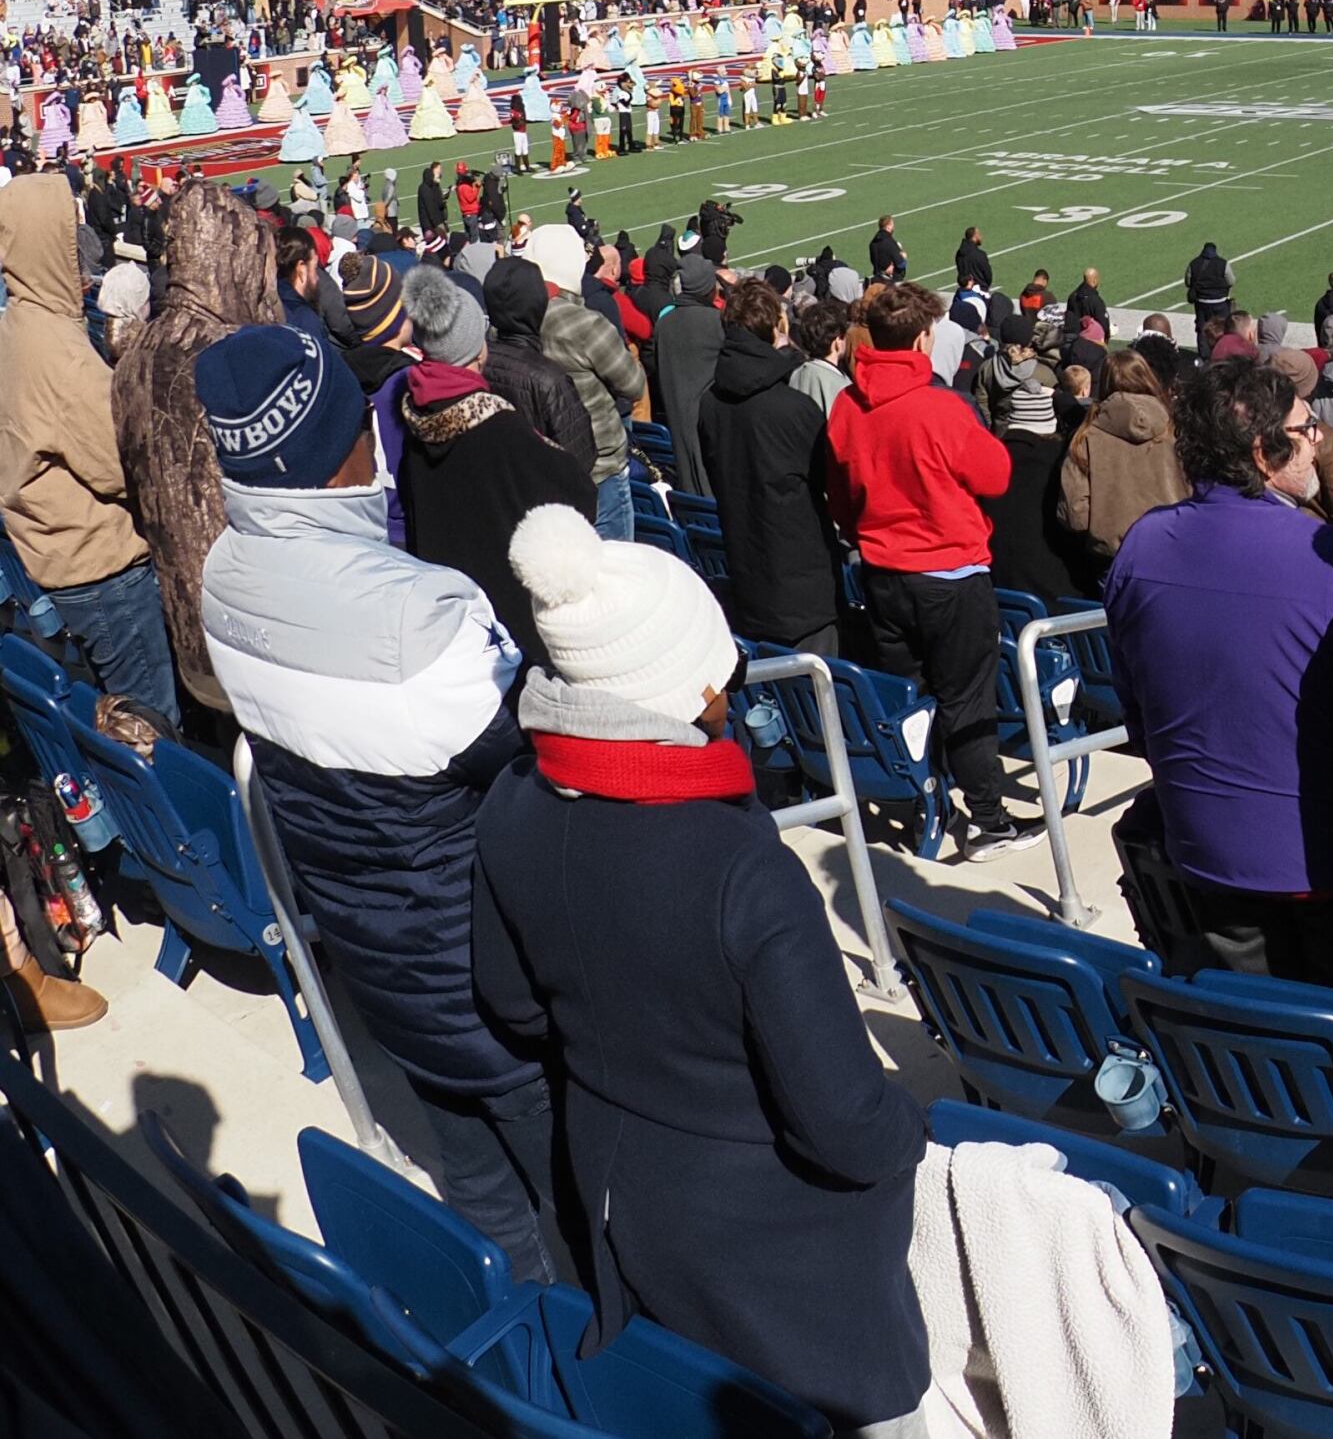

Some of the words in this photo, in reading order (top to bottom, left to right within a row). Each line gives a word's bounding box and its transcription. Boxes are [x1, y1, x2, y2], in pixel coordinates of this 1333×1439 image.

[976, 151, 1193, 166] ABRAHAM
[976, 160, 1170, 175] MITCHELL
[986, 169, 1104, 181] FIELD
[1033, 205, 1189, 228] 30
[267, 927, 281, 941] 14
